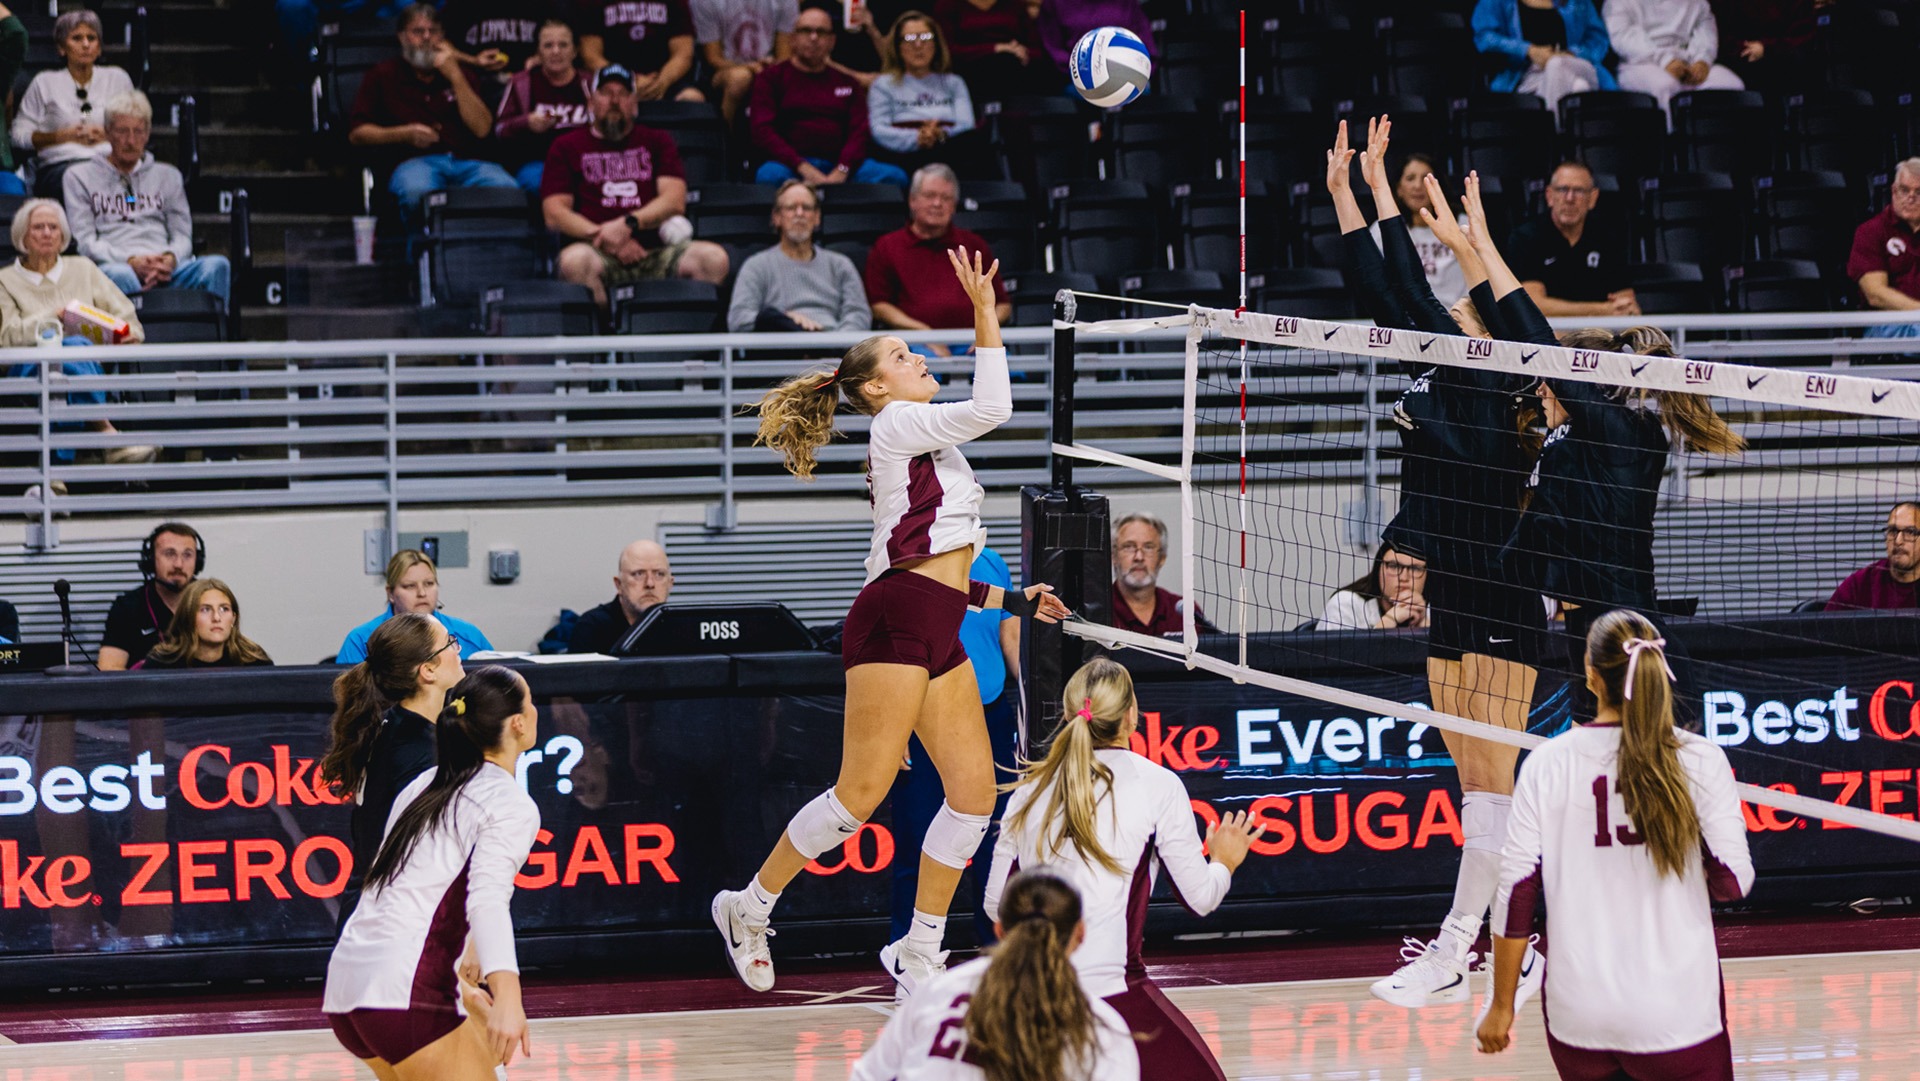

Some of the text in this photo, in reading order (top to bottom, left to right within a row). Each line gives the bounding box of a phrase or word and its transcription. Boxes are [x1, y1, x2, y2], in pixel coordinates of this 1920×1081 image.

[266, 281, 282, 305] C
[1274, 317, 1837, 396] EKU EKU EKU EKU EKU EKU
[700, 621, 740, 640] POSS
[1237, 702, 1433, 767] Ever?
[1703, 686, 1861, 747] Best
[0, 751, 167, 815] Best
[120, 835, 354, 906] ZERO
